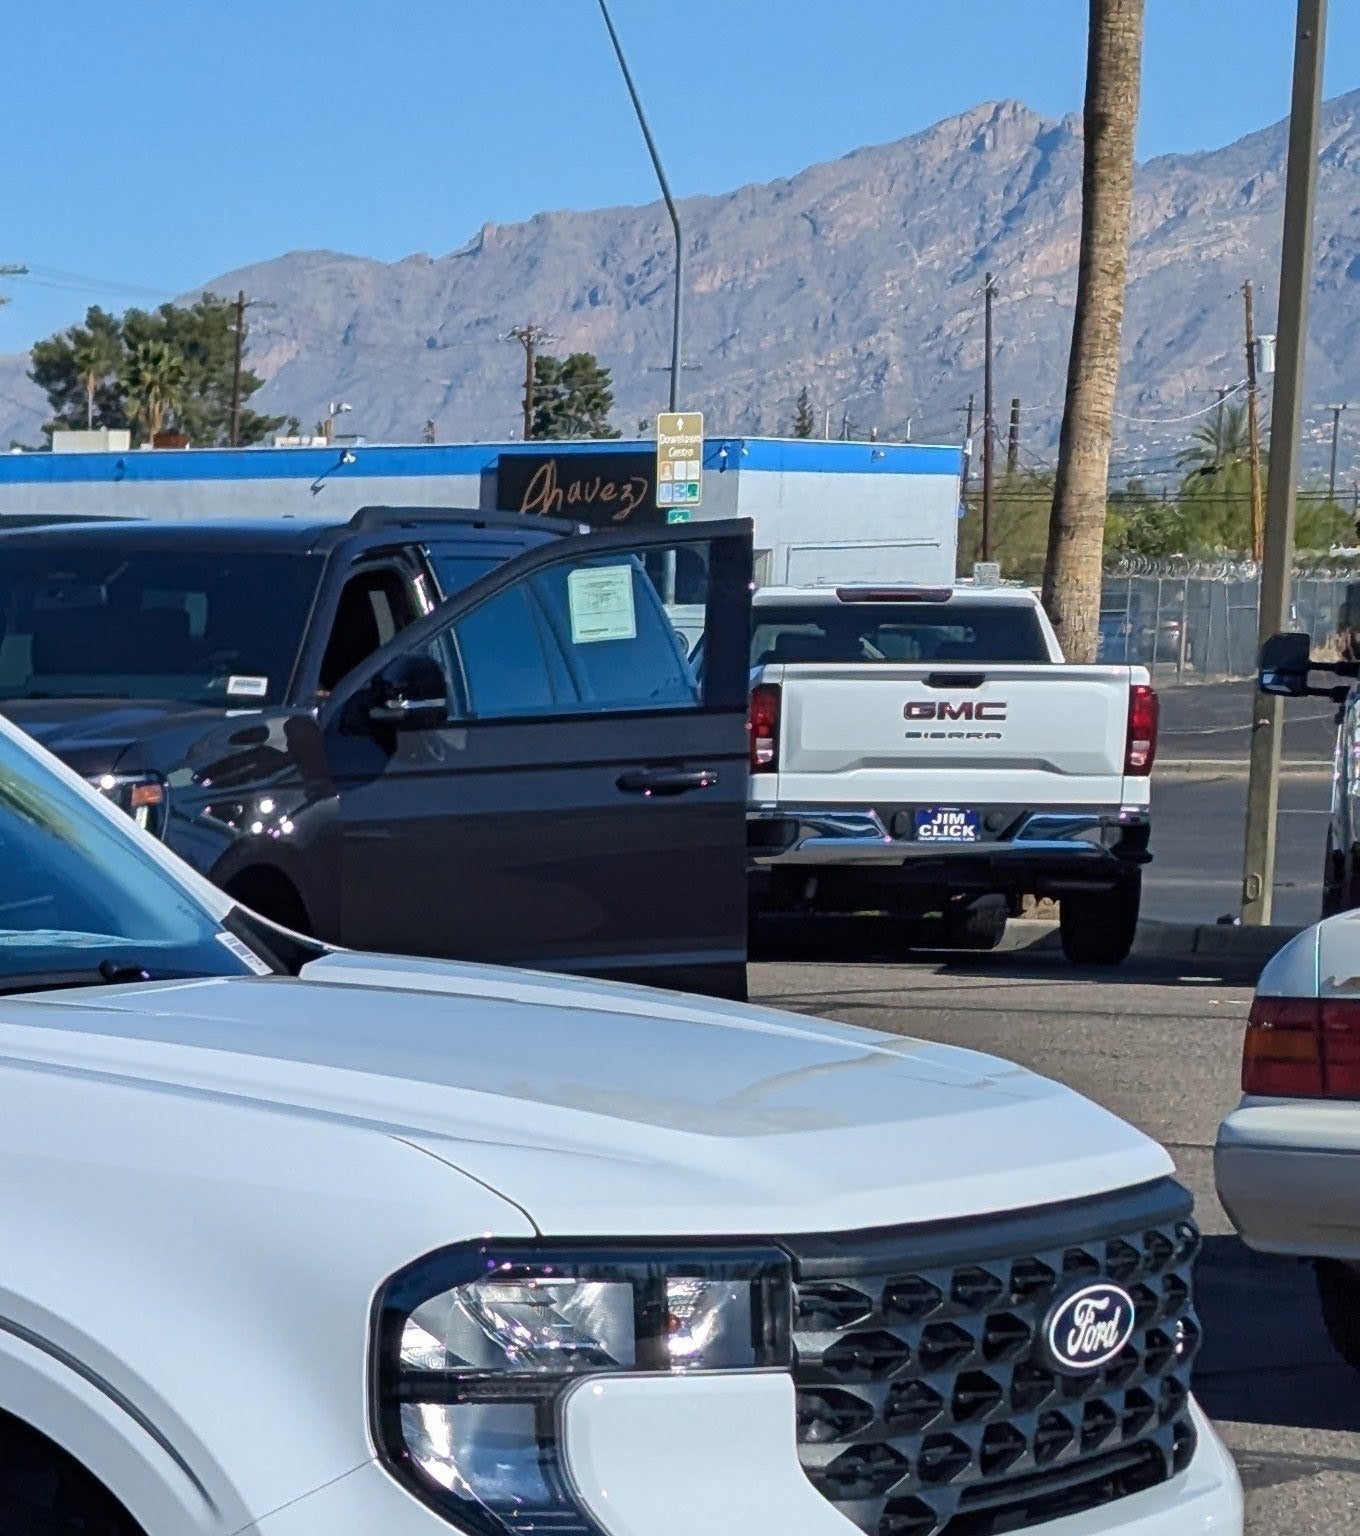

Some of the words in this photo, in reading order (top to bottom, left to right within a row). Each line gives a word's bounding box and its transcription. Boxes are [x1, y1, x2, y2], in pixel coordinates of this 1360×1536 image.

[659, 433, 702, 445] Downtown
[668, 446, 693, 457] Centro
[902, 700, 1008, 721] GMC
[904, 731, 1002, 740] SIERRA
[931, 812, 966, 825] JIM
[919, 824, 976, 837] CLICK
[1066, 1295, 1122, 1356] Ford
